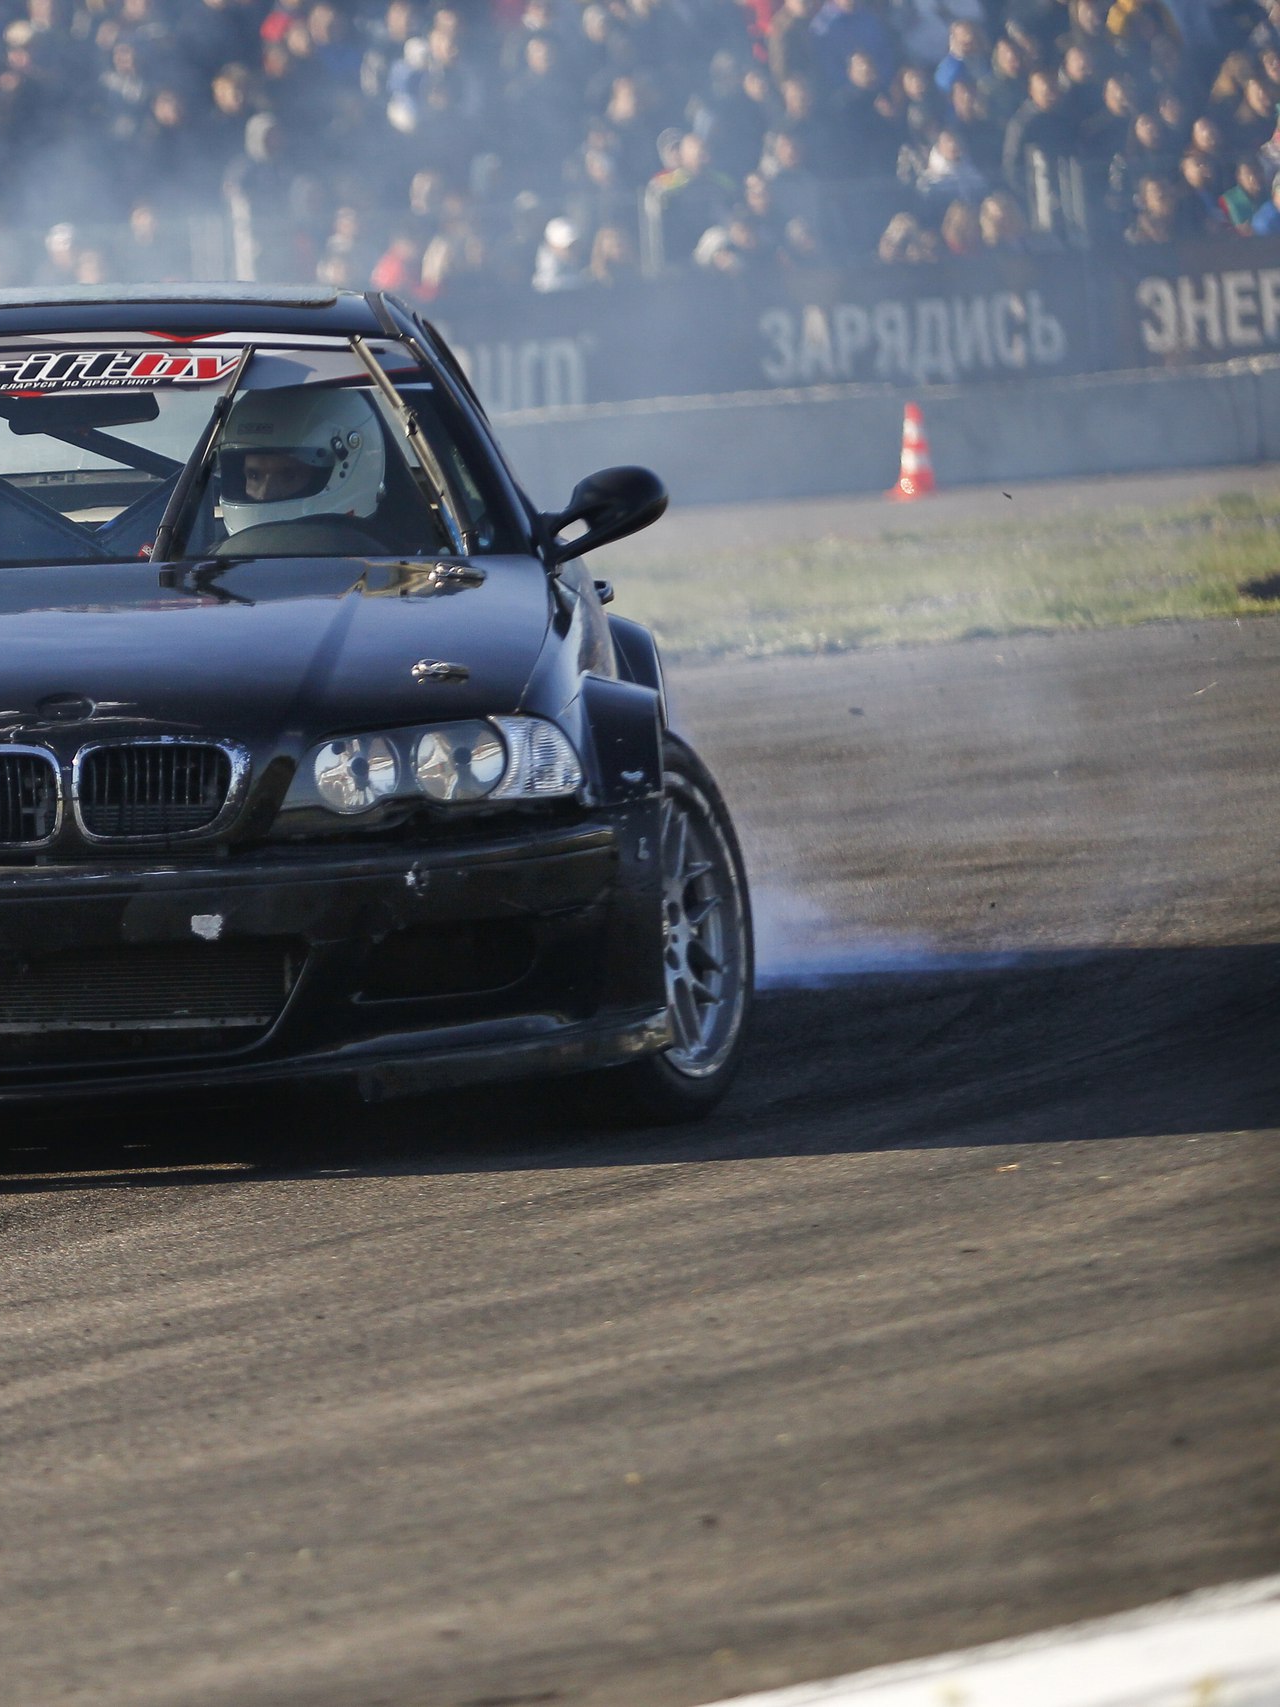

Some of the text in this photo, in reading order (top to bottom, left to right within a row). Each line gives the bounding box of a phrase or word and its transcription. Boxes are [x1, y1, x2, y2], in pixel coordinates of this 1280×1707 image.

[760, 291, 1067, 381] ЗАРЯДИСЬ
[62, 380, 80, 388] ПО
[82, 378, 161, 388] ДРИФТИНГУ
